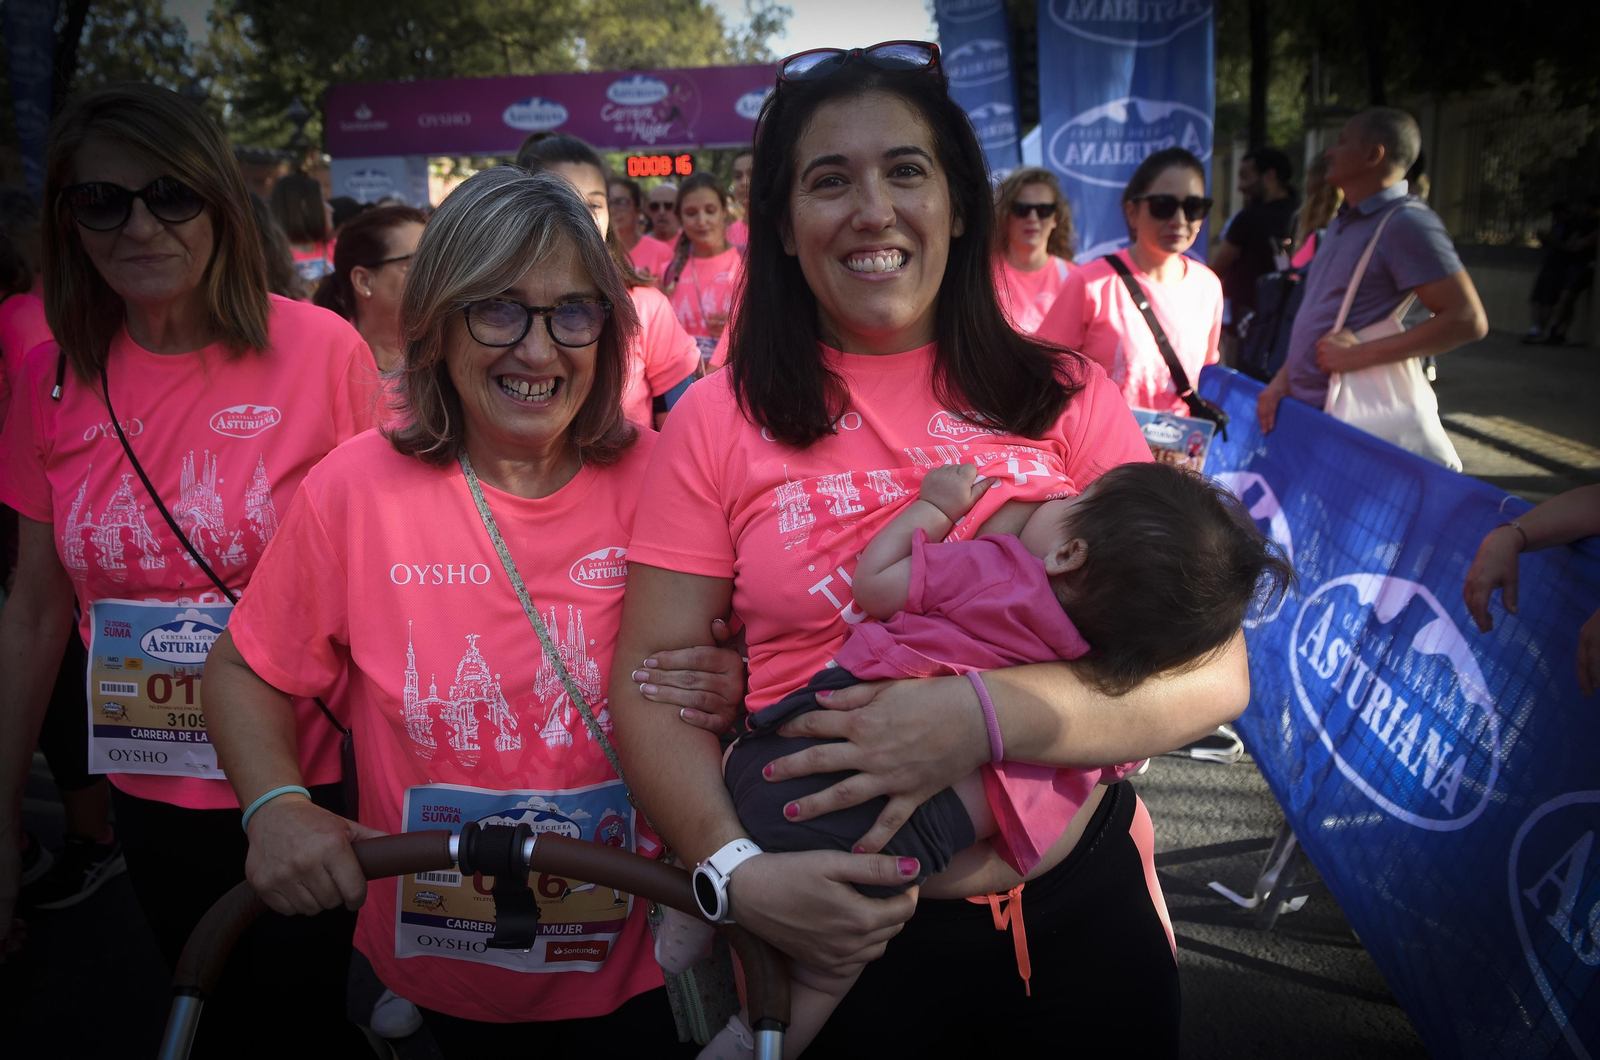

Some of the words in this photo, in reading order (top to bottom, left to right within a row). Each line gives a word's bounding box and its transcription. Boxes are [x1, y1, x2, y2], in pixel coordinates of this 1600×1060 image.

[216, 414, 276, 430] ASTURIANA
[390, 563, 491, 585] OYSHO
[104, 620, 112, 628] TU
[112, 621, 132, 629] DORSAL
[104, 627, 132, 638] SUMA
[147, 635, 214, 654] ASTURIA
[146, 673, 195, 706] 01
[1298, 602, 1468, 815] ASTURIANA
[131, 728, 176, 741] CARRERA
[178, 730, 191, 741] DE
[195, 731, 208, 742] LA
[109, 749, 168, 764] OYSHO
[433, 805, 462, 815] DORSAL
[422, 812, 461, 824] SUMA
[473, 870, 568, 898] 06
[543, 924, 583, 934] MUJER
[417, 935, 488, 954] OYSHO
[564, 947, 600, 955] Santander
